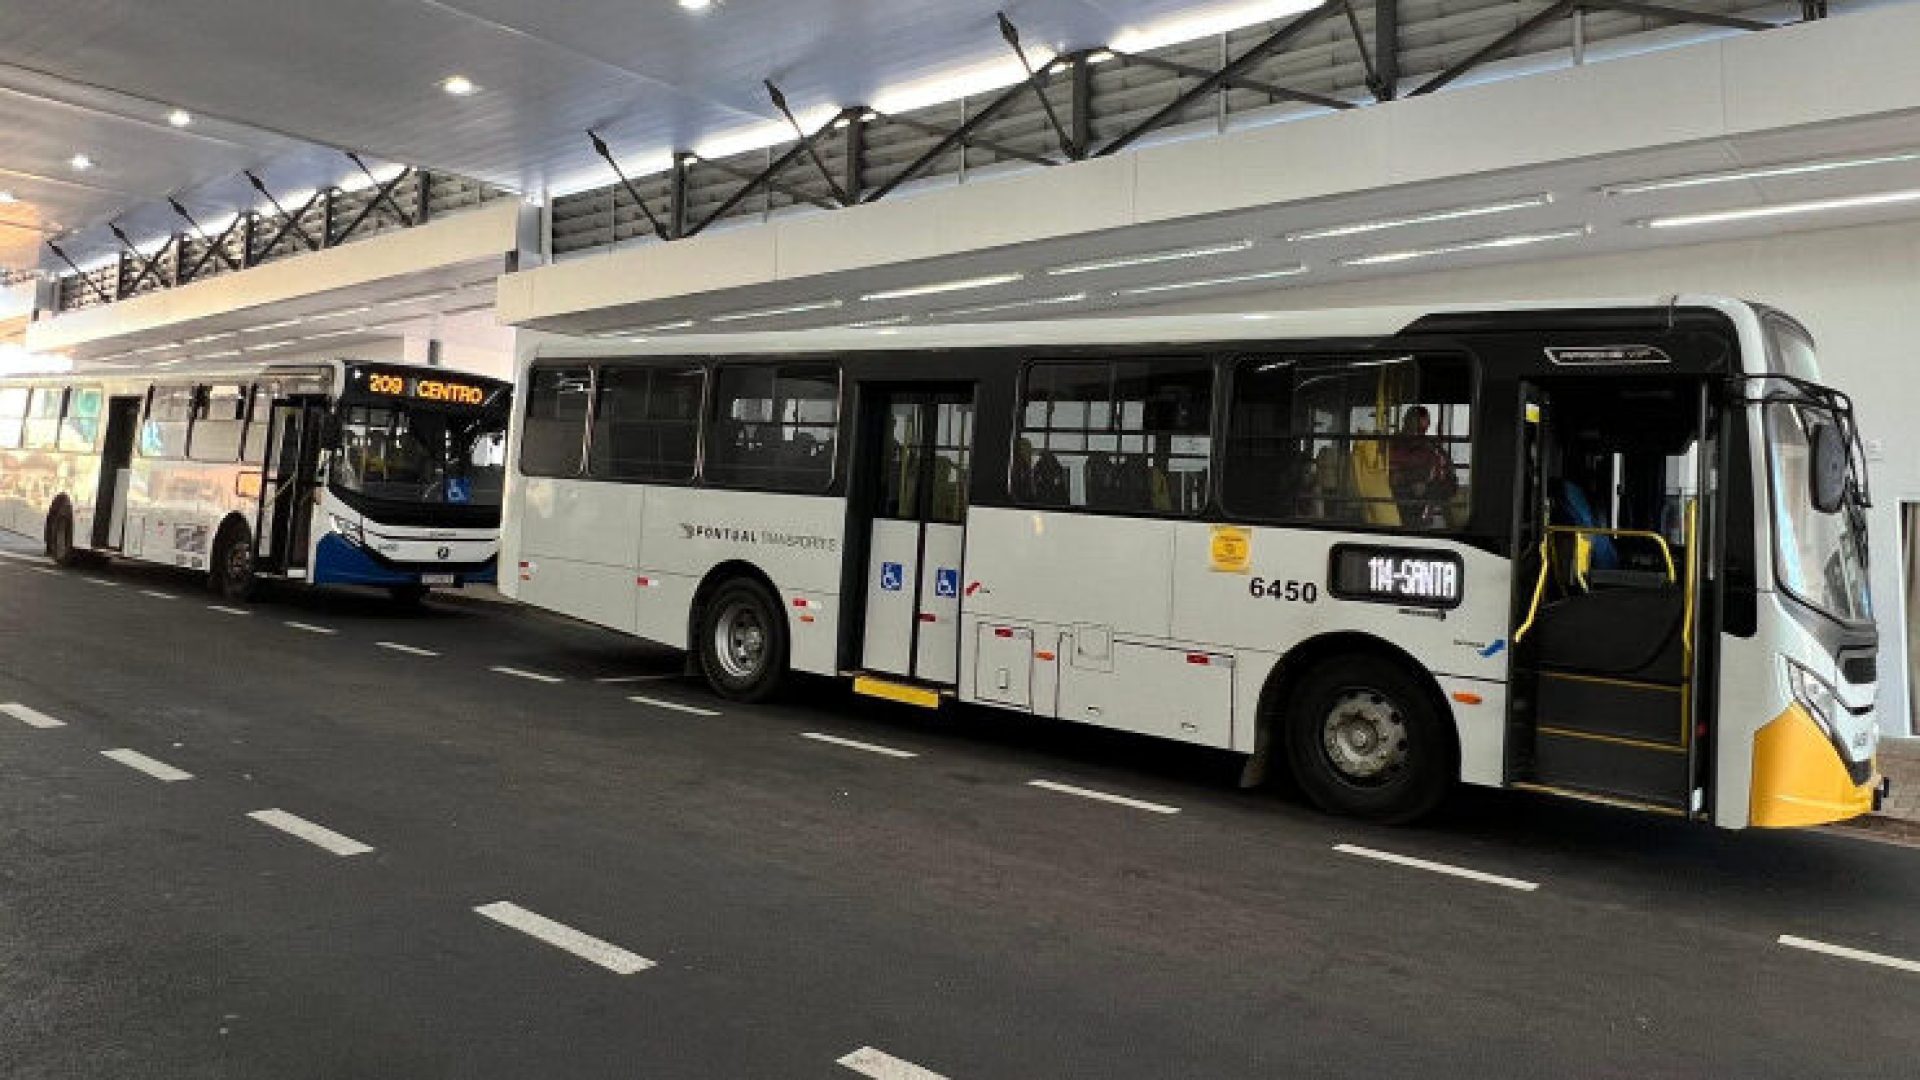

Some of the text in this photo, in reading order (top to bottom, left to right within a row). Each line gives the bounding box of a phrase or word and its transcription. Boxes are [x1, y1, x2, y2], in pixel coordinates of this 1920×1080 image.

[369, 373, 483, 405] 209 CENTRO
[696, 525, 757, 543] PONTUAL
[1249, 577, 1317, 604] 6450
